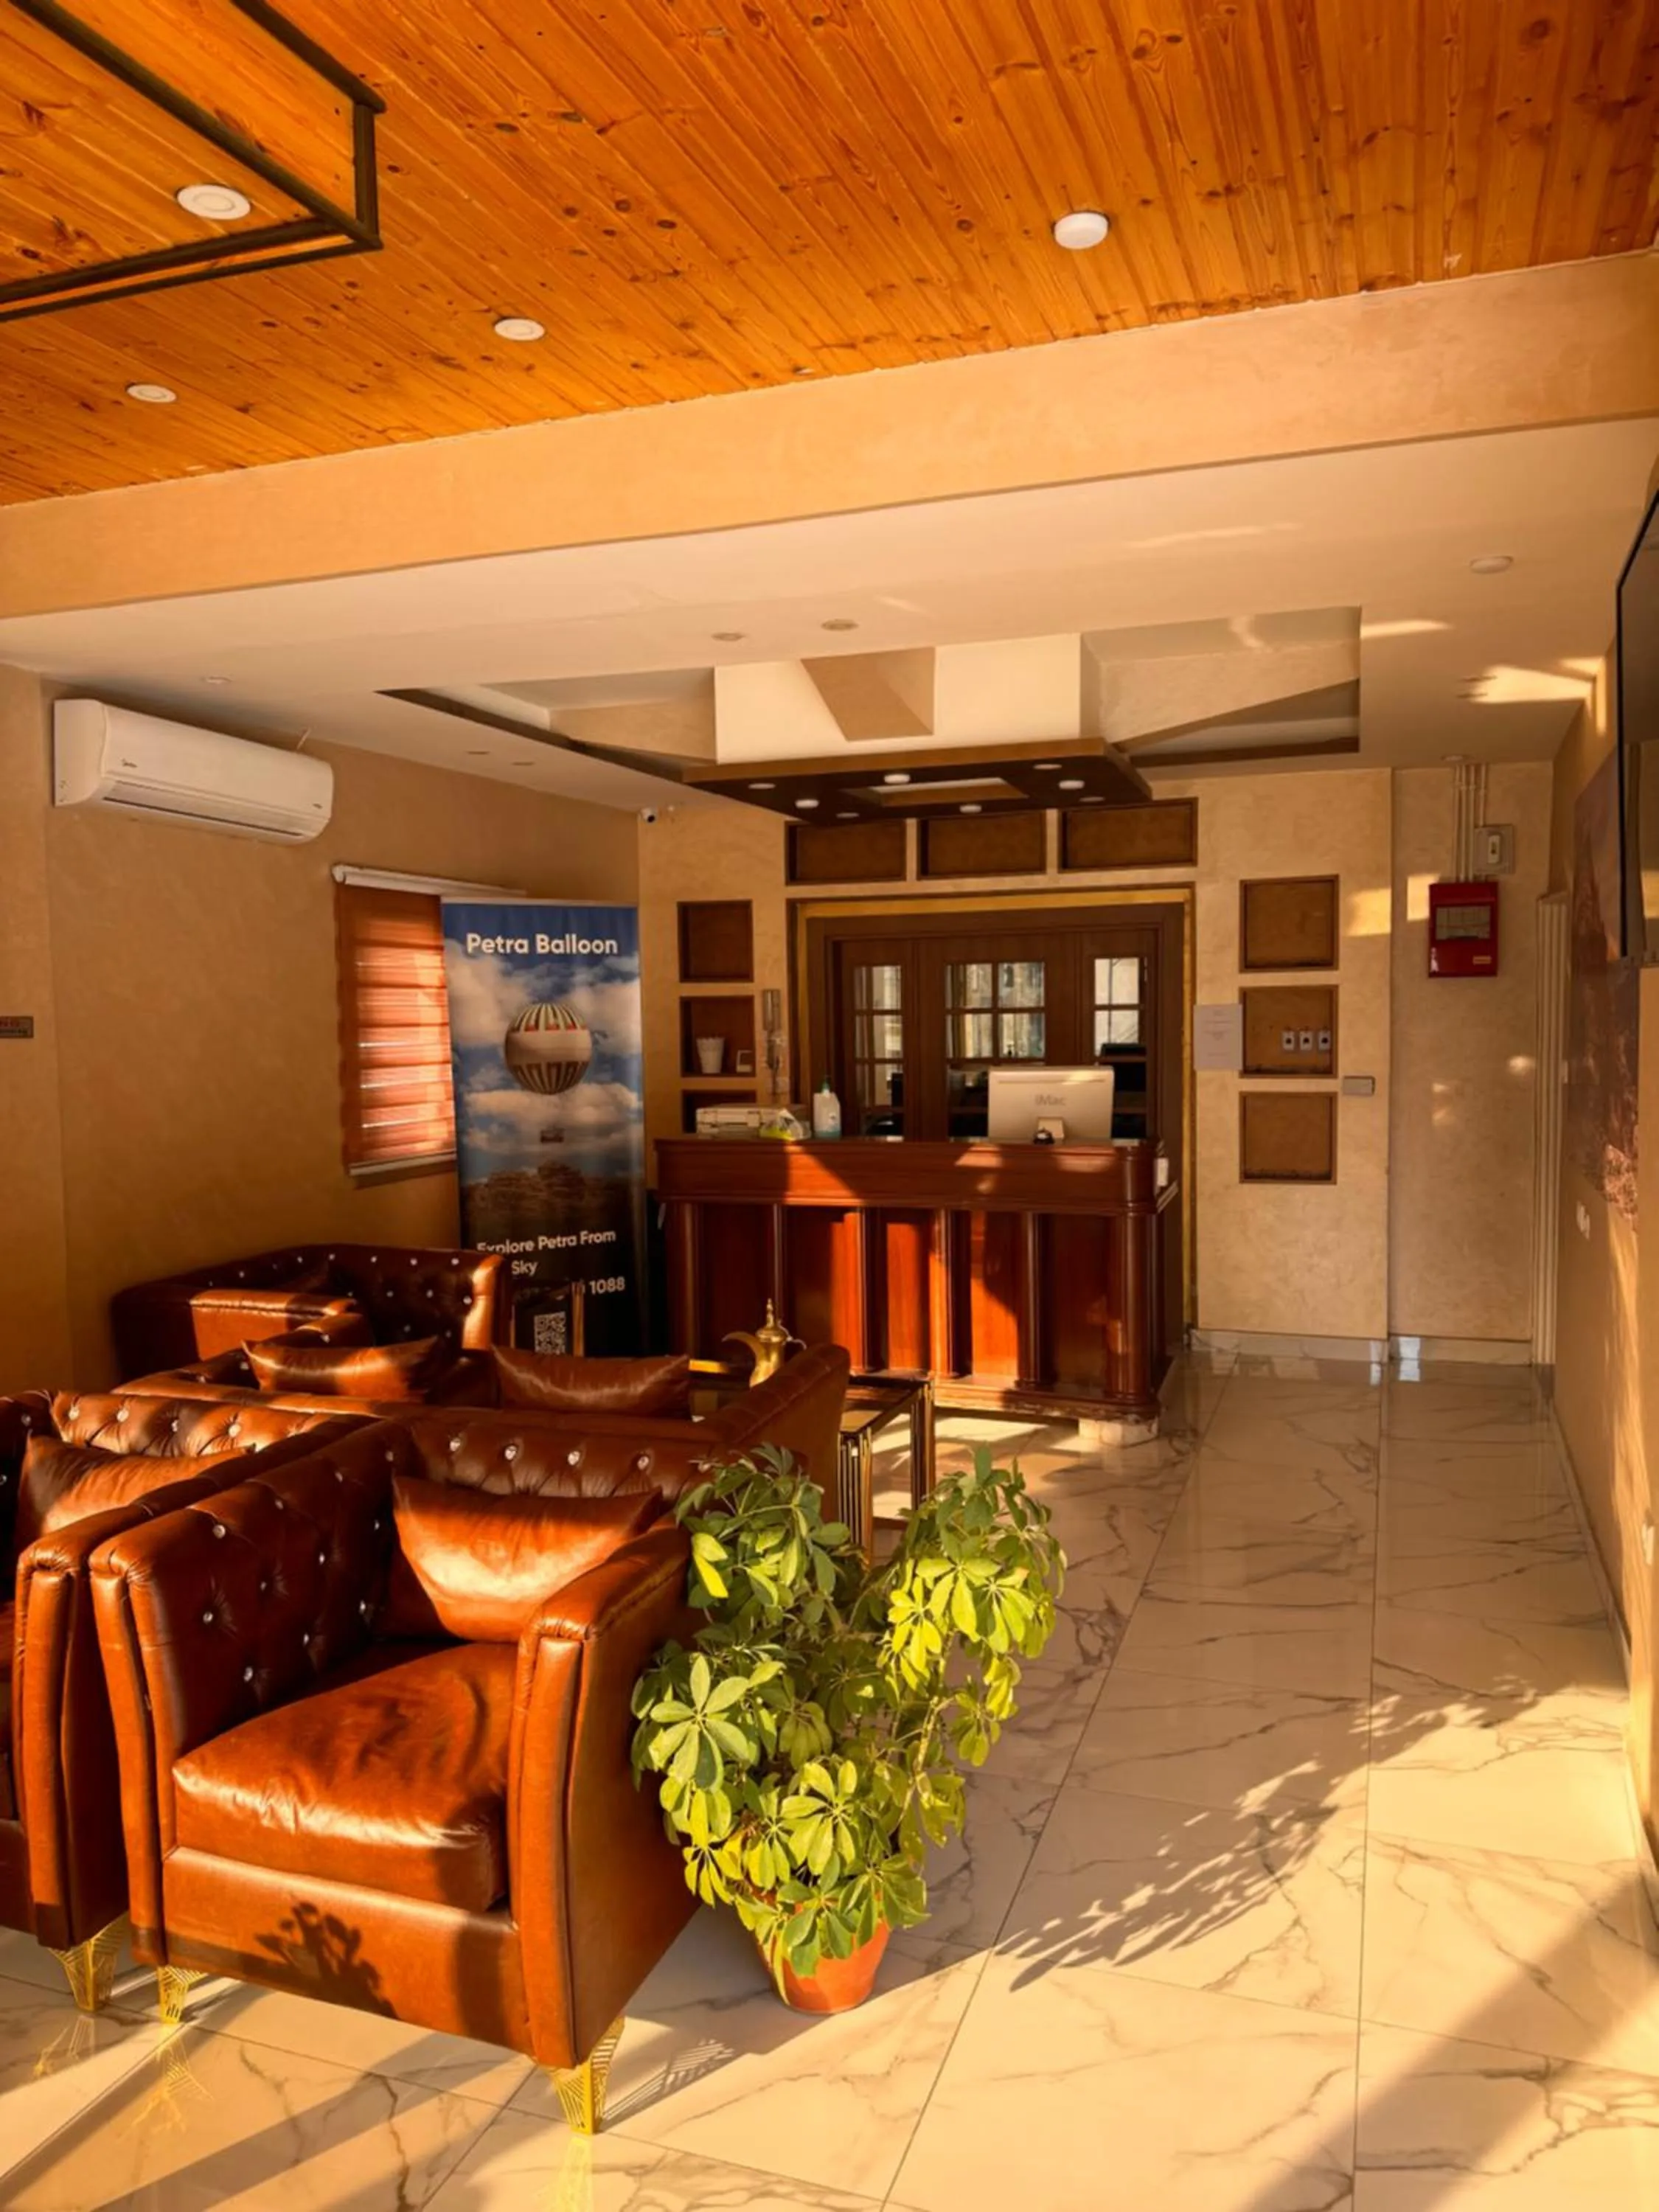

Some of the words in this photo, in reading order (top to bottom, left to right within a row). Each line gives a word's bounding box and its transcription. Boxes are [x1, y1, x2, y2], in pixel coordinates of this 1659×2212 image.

[466, 933, 529, 954] Petra
[535, 933, 618, 954] Balloon
[1035, 1093, 1066, 1106] iMac
[538, 1234, 577, 1251] Petra
[580, 1229, 616, 1245] From
[511, 1260, 538, 1276] Sky
[588, 1276, 626, 1295] 1088
